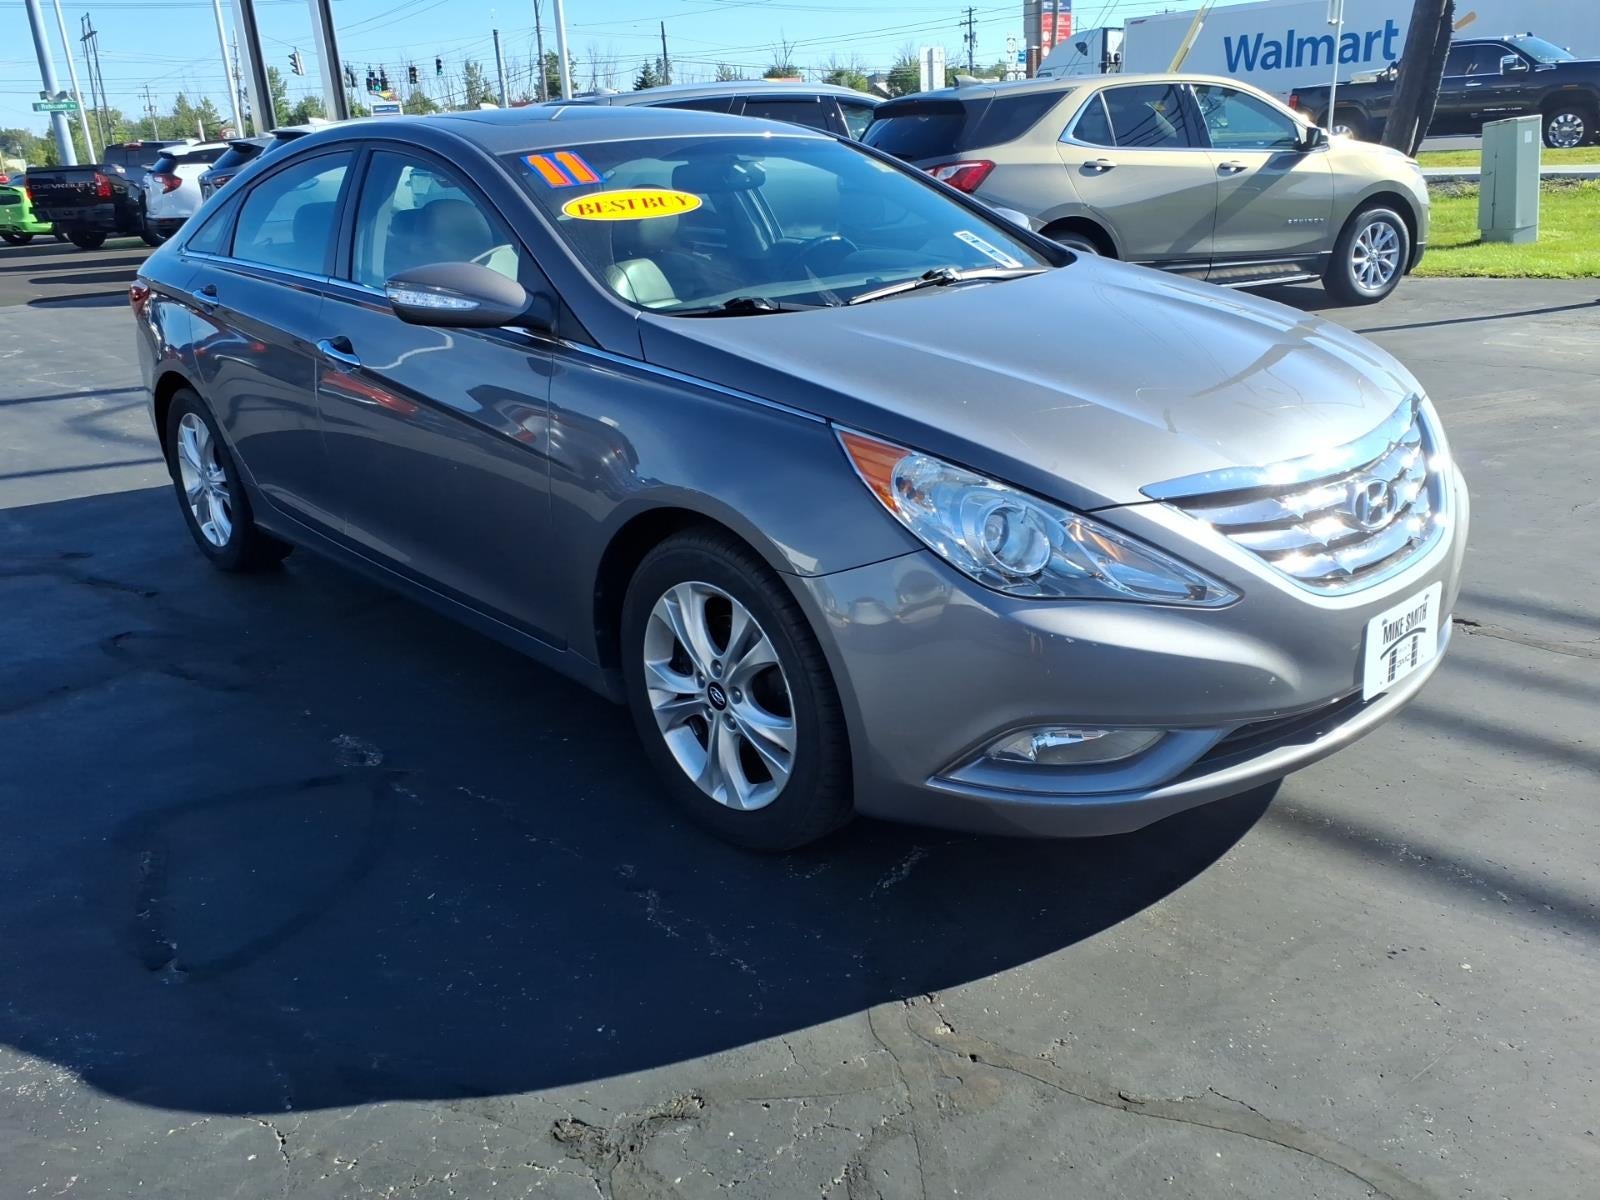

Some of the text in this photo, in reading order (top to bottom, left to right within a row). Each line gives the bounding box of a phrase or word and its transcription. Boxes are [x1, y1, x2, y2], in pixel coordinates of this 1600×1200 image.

[1224, 19, 1399, 73] Walmart
[525, 150, 605, 187] 11
[577, 194, 688, 216] BEST BUY
[1383, 602, 1428, 645] MIKE SMITH
